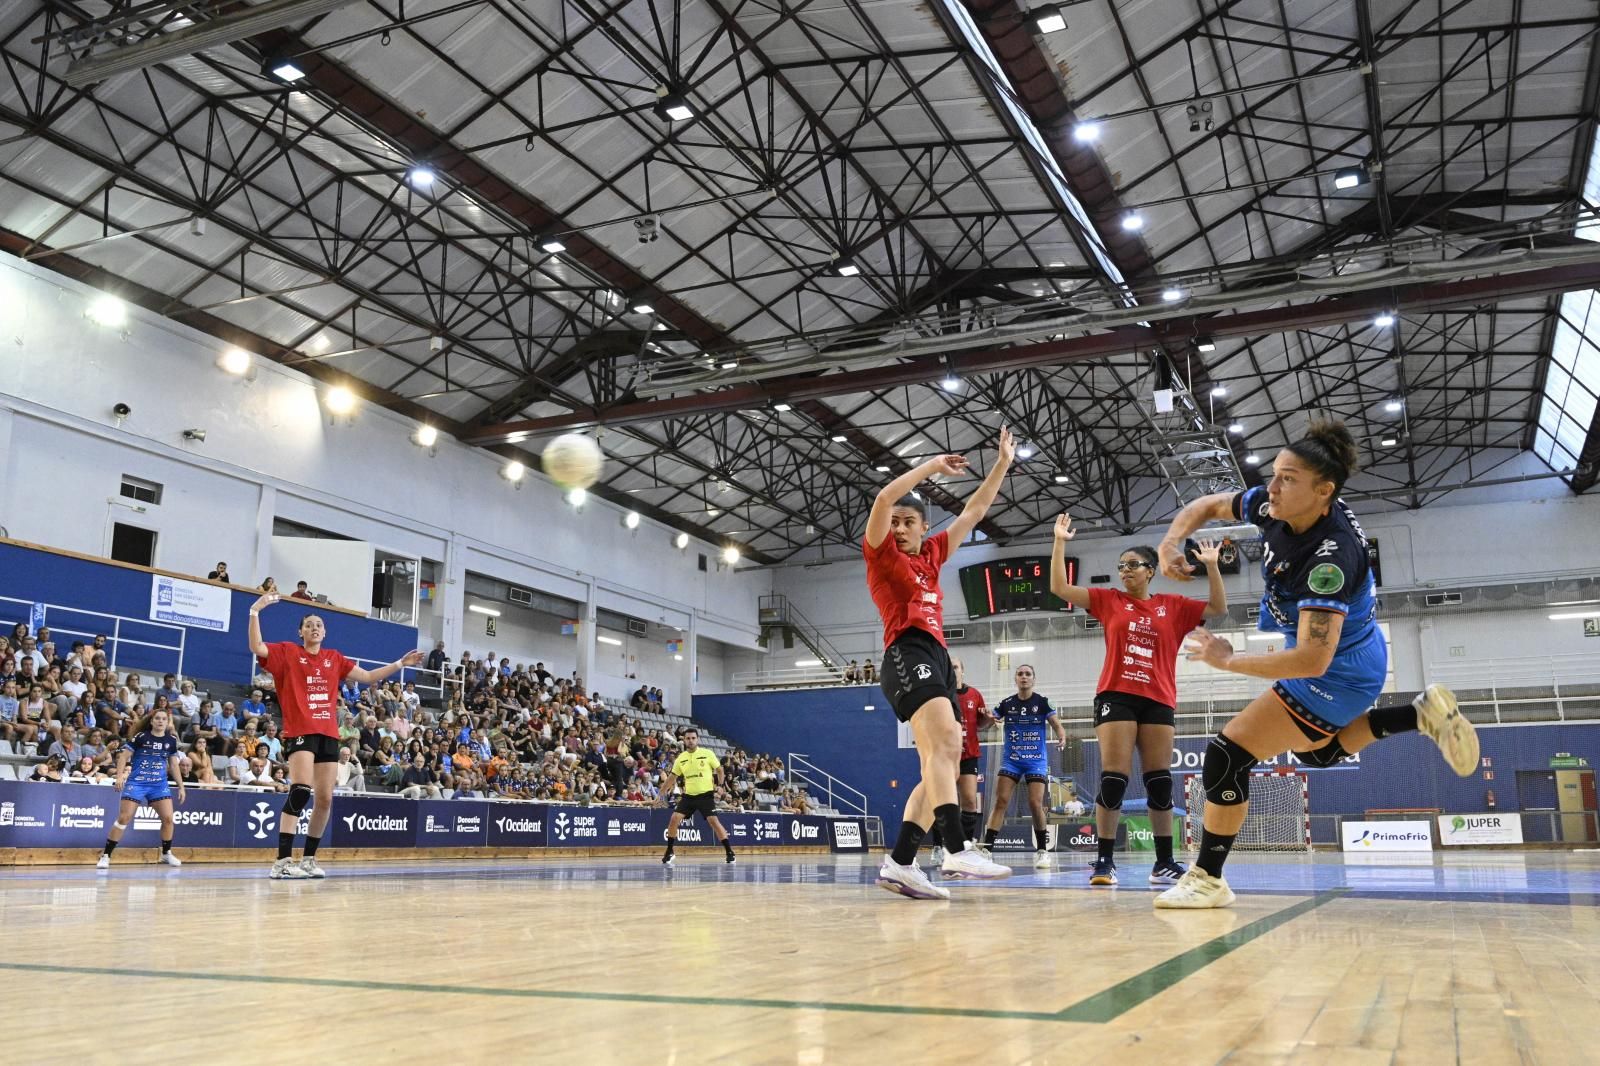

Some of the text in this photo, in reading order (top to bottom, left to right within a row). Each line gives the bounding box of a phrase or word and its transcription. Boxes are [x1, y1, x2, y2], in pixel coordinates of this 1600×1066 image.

[1009, 583, 1032, 593] 11:27
[1139, 617, 1151, 625] 23
[1020, 707, 1027, 716] 2
[61, 805, 104, 815] Donostia
[357, 815, 408, 831] Occident
[457, 815, 481, 824] Donostia
[573, 816, 595, 827] super
[1466, 817, 1501, 830] JUPER
[505, 818, 541, 833] Occident
[573, 827, 598, 837] amara
[663, 828, 701, 842] GUZKOA
[835, 825, 860, 837] EUSKADI
